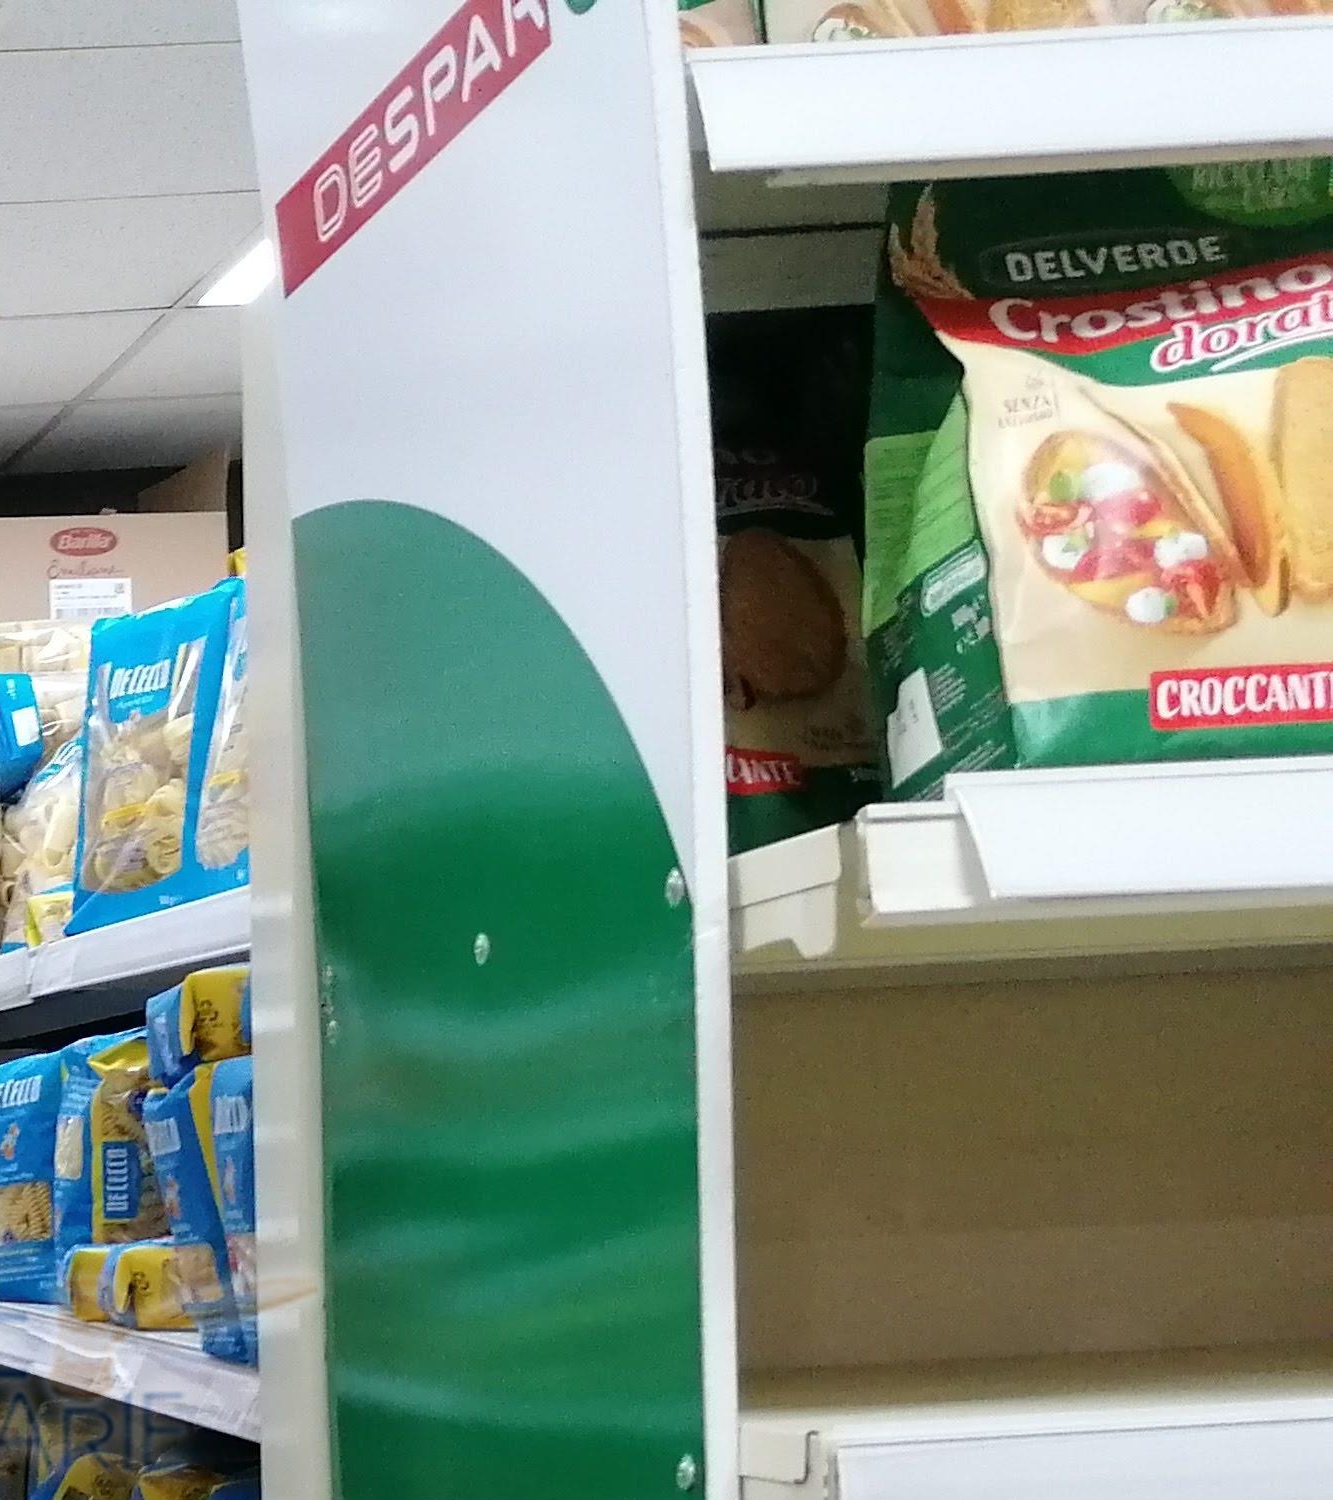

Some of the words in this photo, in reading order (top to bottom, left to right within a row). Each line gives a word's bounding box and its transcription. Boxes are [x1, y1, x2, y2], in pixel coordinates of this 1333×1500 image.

[1005, 235, 1226, 282] DELVERDE
[988, 264, 1333, 343] Crostino
[1150, 291, 1333, 373] dorat
[1158, 672, 1333, 723] CROCCANT
